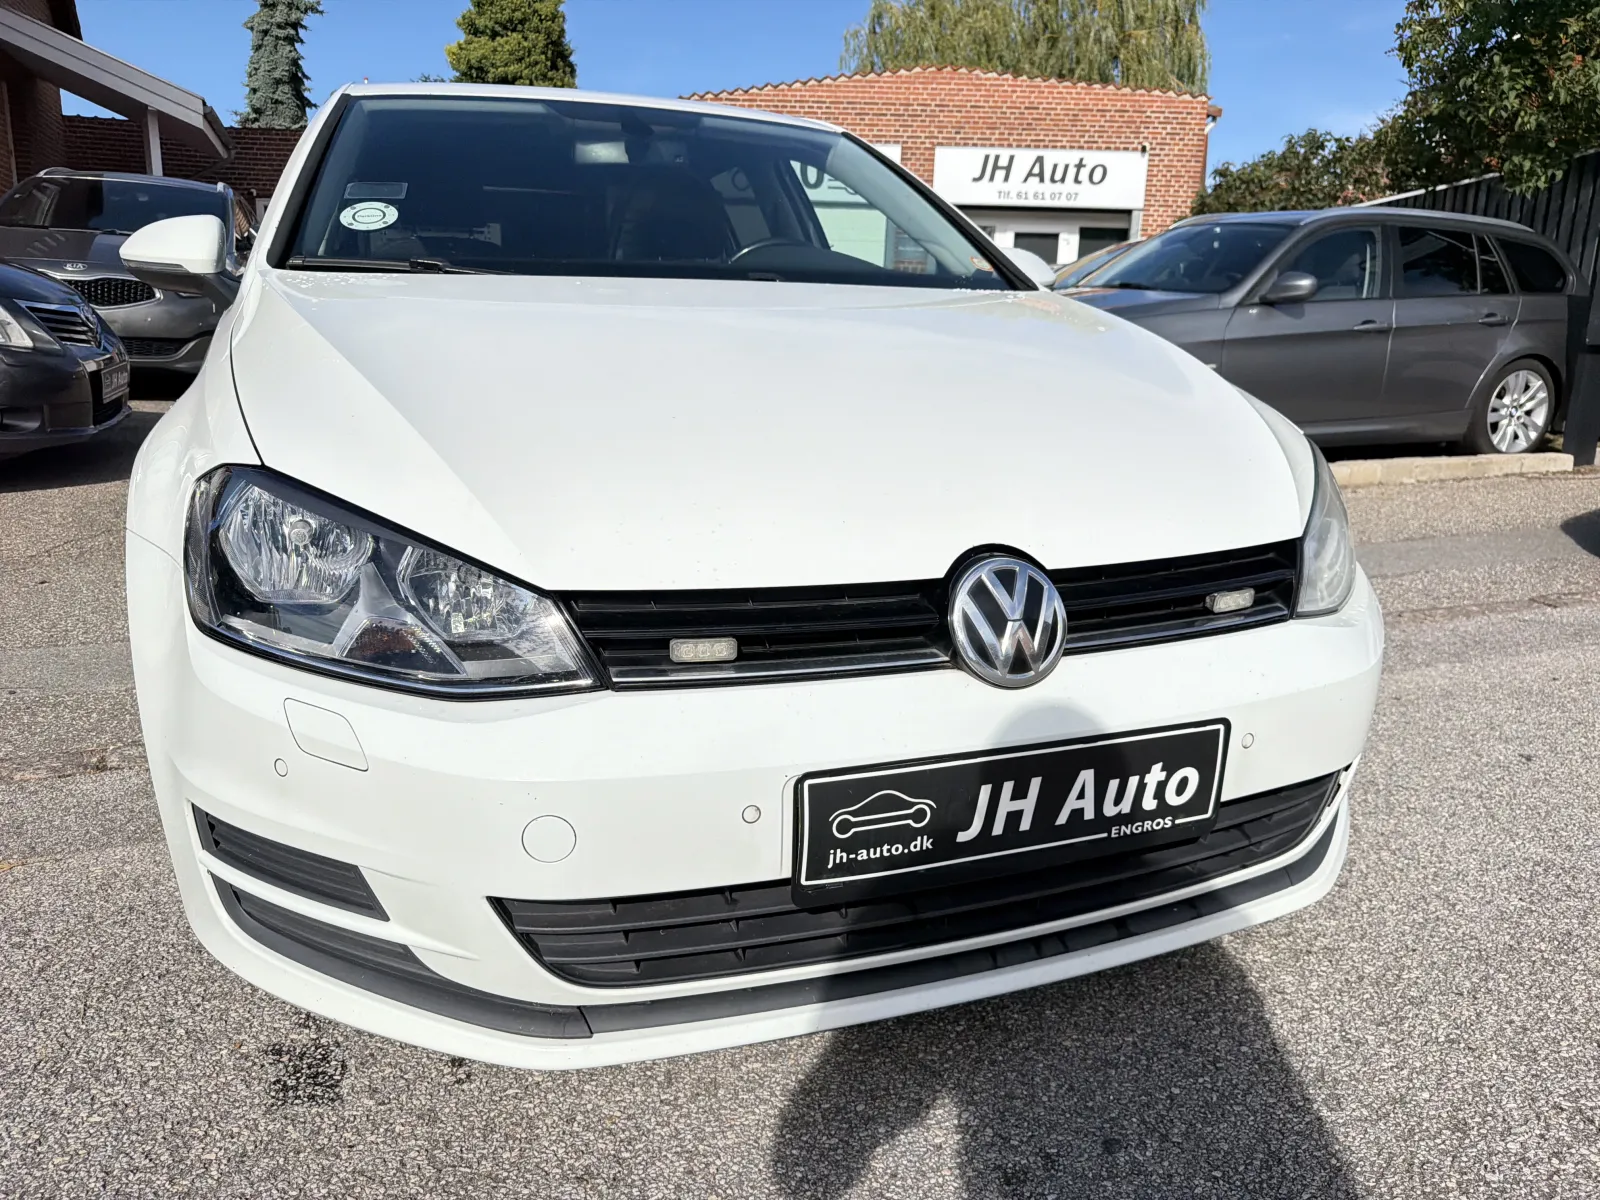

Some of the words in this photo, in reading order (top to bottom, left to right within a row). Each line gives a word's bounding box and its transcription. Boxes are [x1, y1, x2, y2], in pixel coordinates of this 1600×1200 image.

[972, 154, 1015, 183] JH
[1022, 155, 1108, 185] Auto
[1016, 191, 1029, 200] 61
[1033, 191, 1046, 201] 61
[1050, 191, 1063, 201] 07
[1065, 192, 1079, 202] 07
[956, 776, 1042, 843] JH
[1055, 762, 1200, 826] Auto
[1111, 816, 1174, 839] ENGROS
[827, 835, 934, 869] jh-auto.dk
